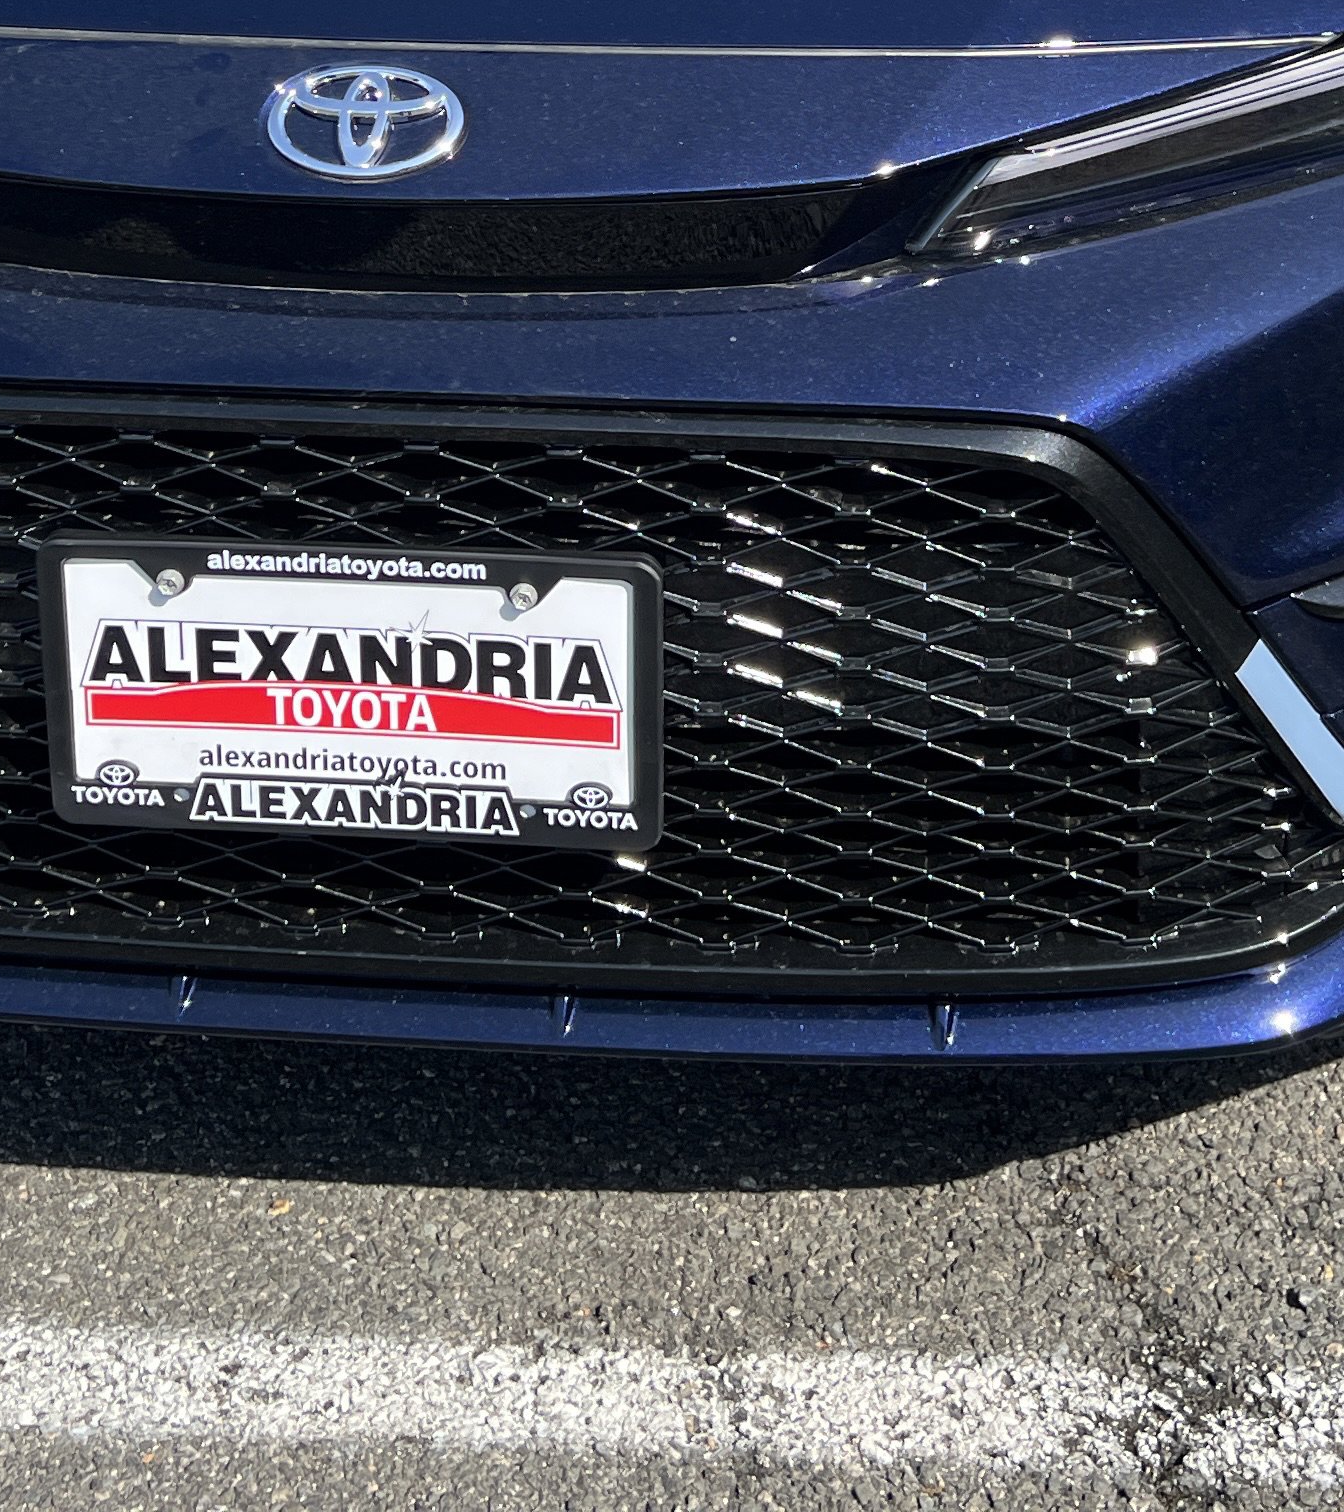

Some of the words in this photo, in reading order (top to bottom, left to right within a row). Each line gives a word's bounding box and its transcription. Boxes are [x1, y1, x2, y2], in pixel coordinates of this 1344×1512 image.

[206, 549, 487, 581] alexandriatoyota.com
[88, 623, 616, 706] ALEXANDRIA
[266, 686, 439, 733] TOYOTA
[198, 743, 507, 782] alexandriatoyota.com
[70, 784, 165, 808] TOYOTA
[194, 778, 520, 835] ALEXANDRIA
[543, 806, 639, 833] TOYOTA
